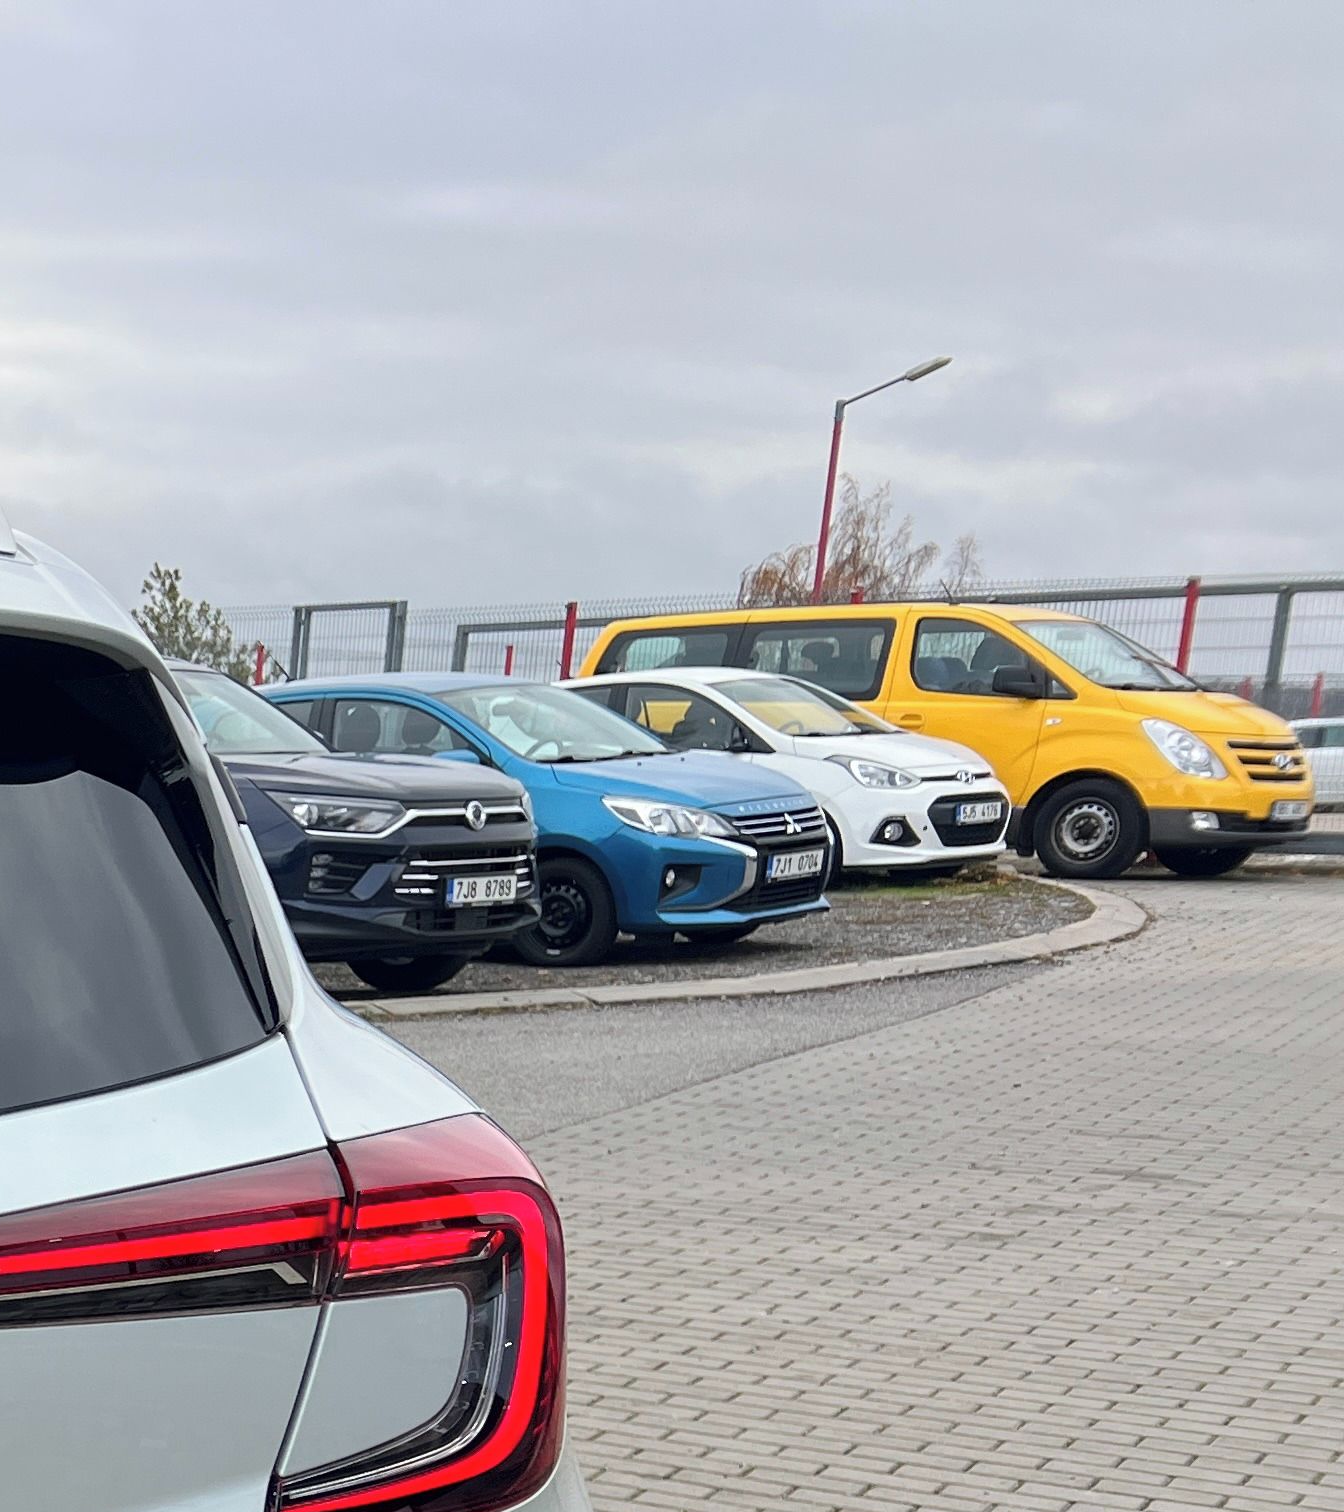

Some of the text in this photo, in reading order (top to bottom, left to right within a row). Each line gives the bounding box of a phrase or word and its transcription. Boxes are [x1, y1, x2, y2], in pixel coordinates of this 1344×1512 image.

[774, 853, 819, 874] 7J1 0704
[456, 879, 512, 899] 7J8 8789
